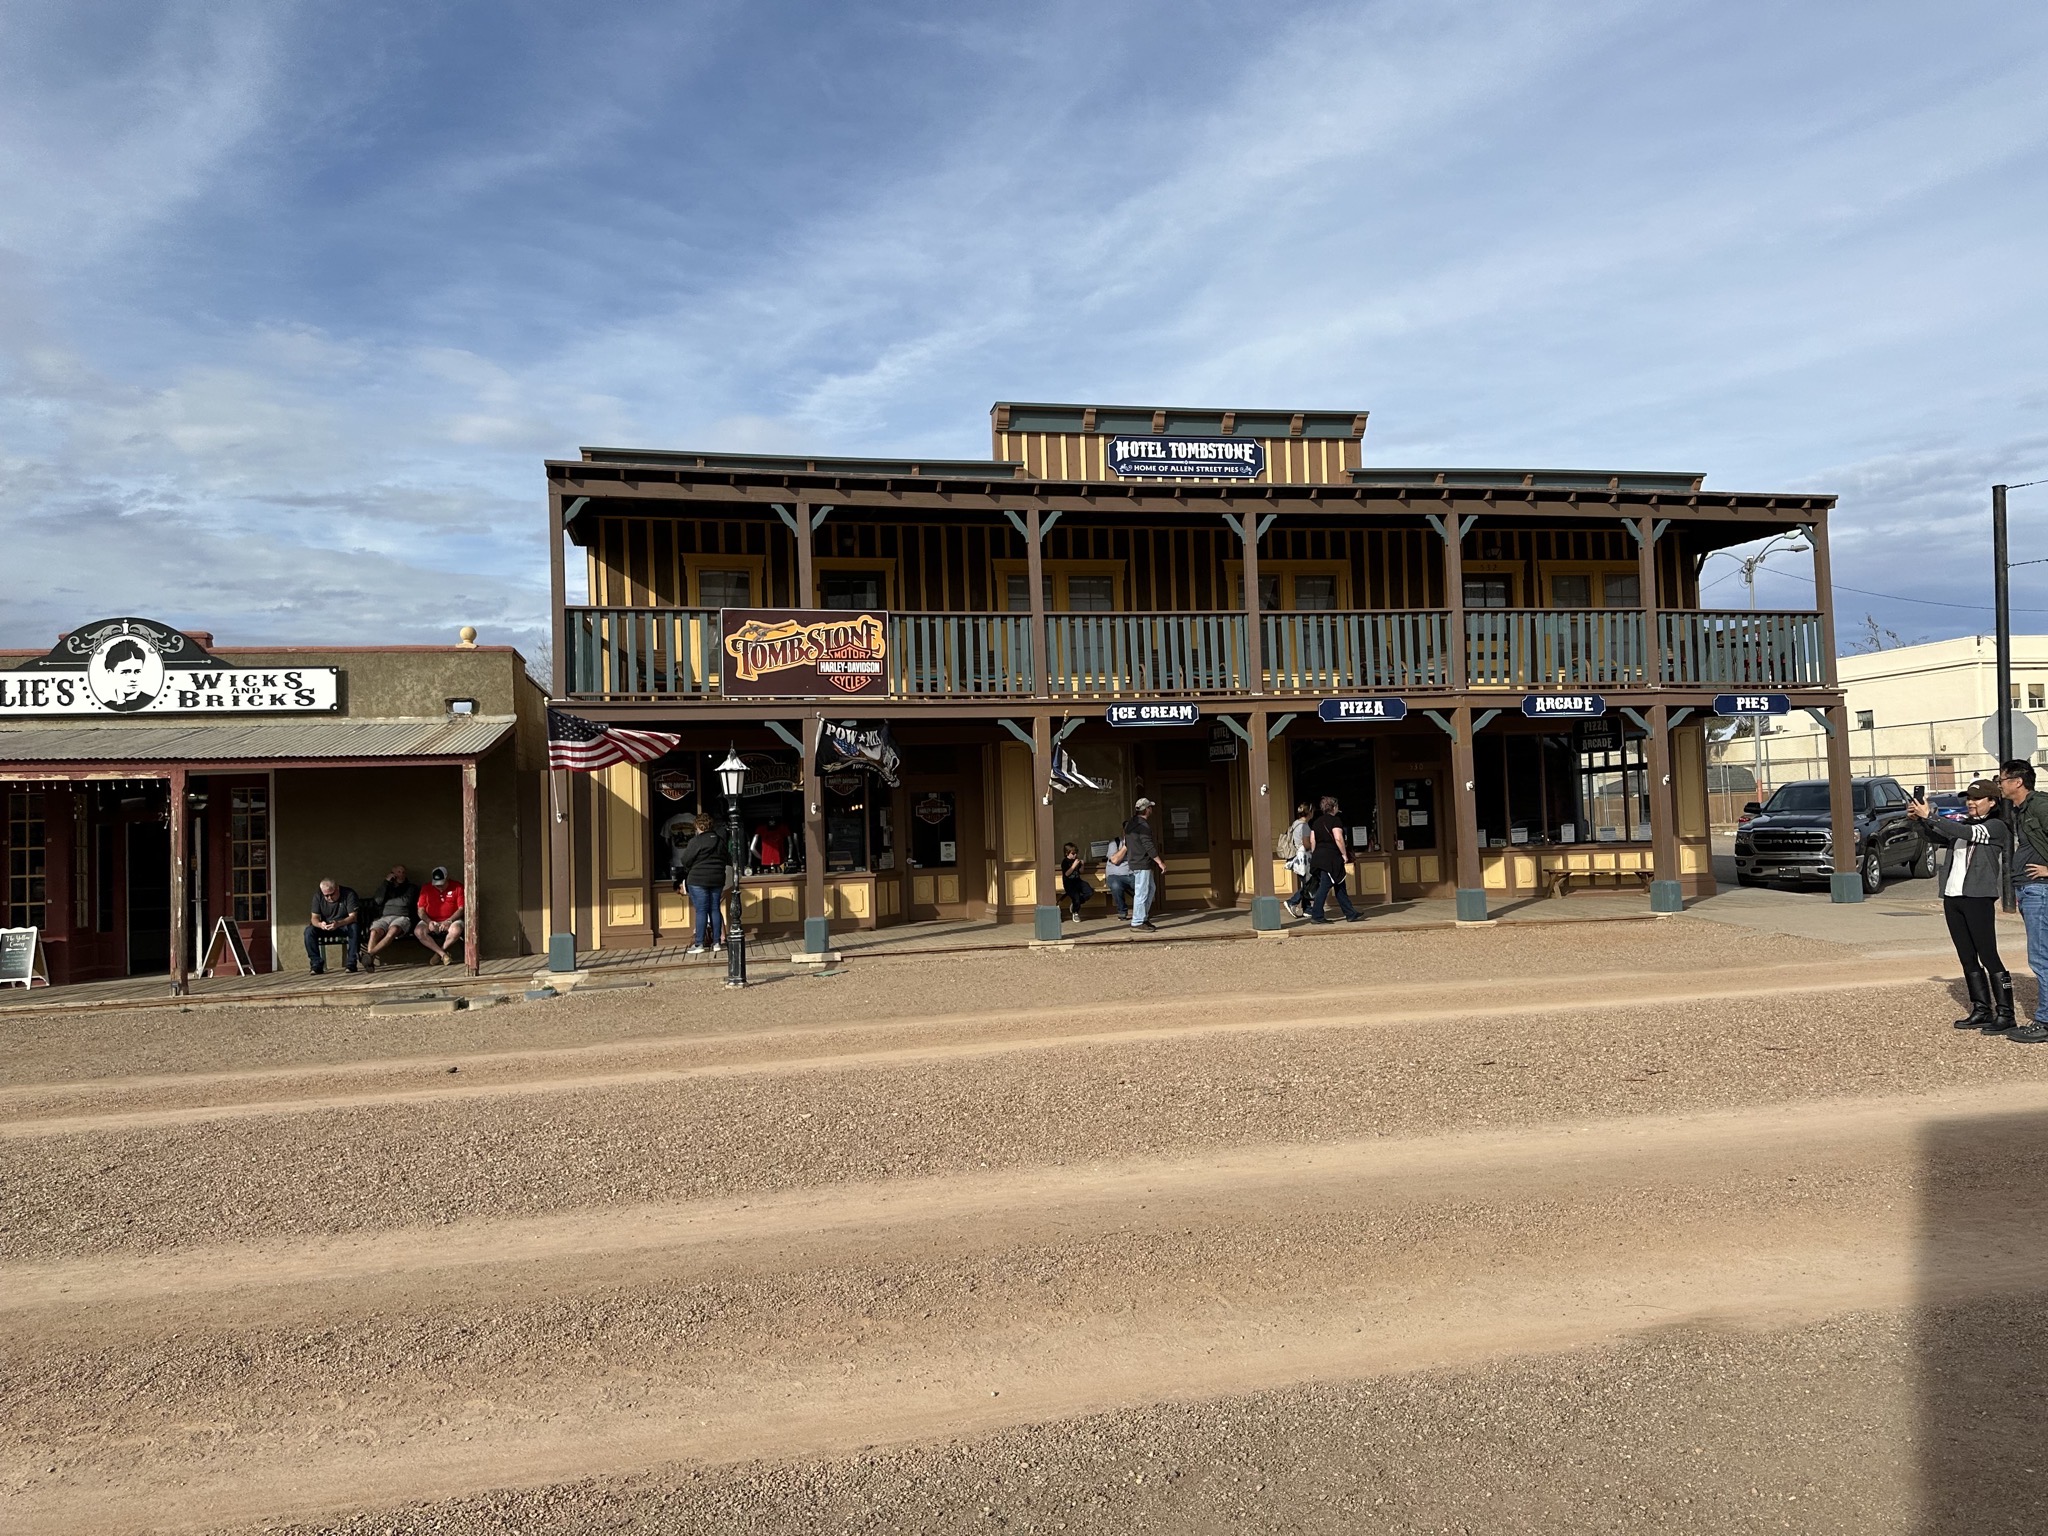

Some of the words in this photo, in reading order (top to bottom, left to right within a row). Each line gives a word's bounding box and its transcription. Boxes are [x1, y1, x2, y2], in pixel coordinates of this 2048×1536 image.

[1116, 441, 1166, 462] HOTEL
[1168, 441, 1256, 465] TOMBSTONE
[731, 620, 881, 676] TOMBSTONE
[834, 650, 866, 659] MOTOR
[820, 661, 880, 674] HARLEY-DAVIDSON
[189, 671, 303, 690] WICKS
[834, 676, 867, 690] CYCLES
[177, 688, 316, 708] BRICKS
[1535, 697, 1594, 712] ARCADE
[1736, 697, 1769, 711] PIES
[1112, 707, 1137, 721] ICE
[1140, 705, 1192, 719] CREAM
[1340, 701, 1385, 716] PIZZA
[1583, 720, 1609, 733] PIZZA
[825, 723, 858, 745] POW
[865, 730, 881, 747] MIA
[1582, 737, 1613, 751] ARCADE
